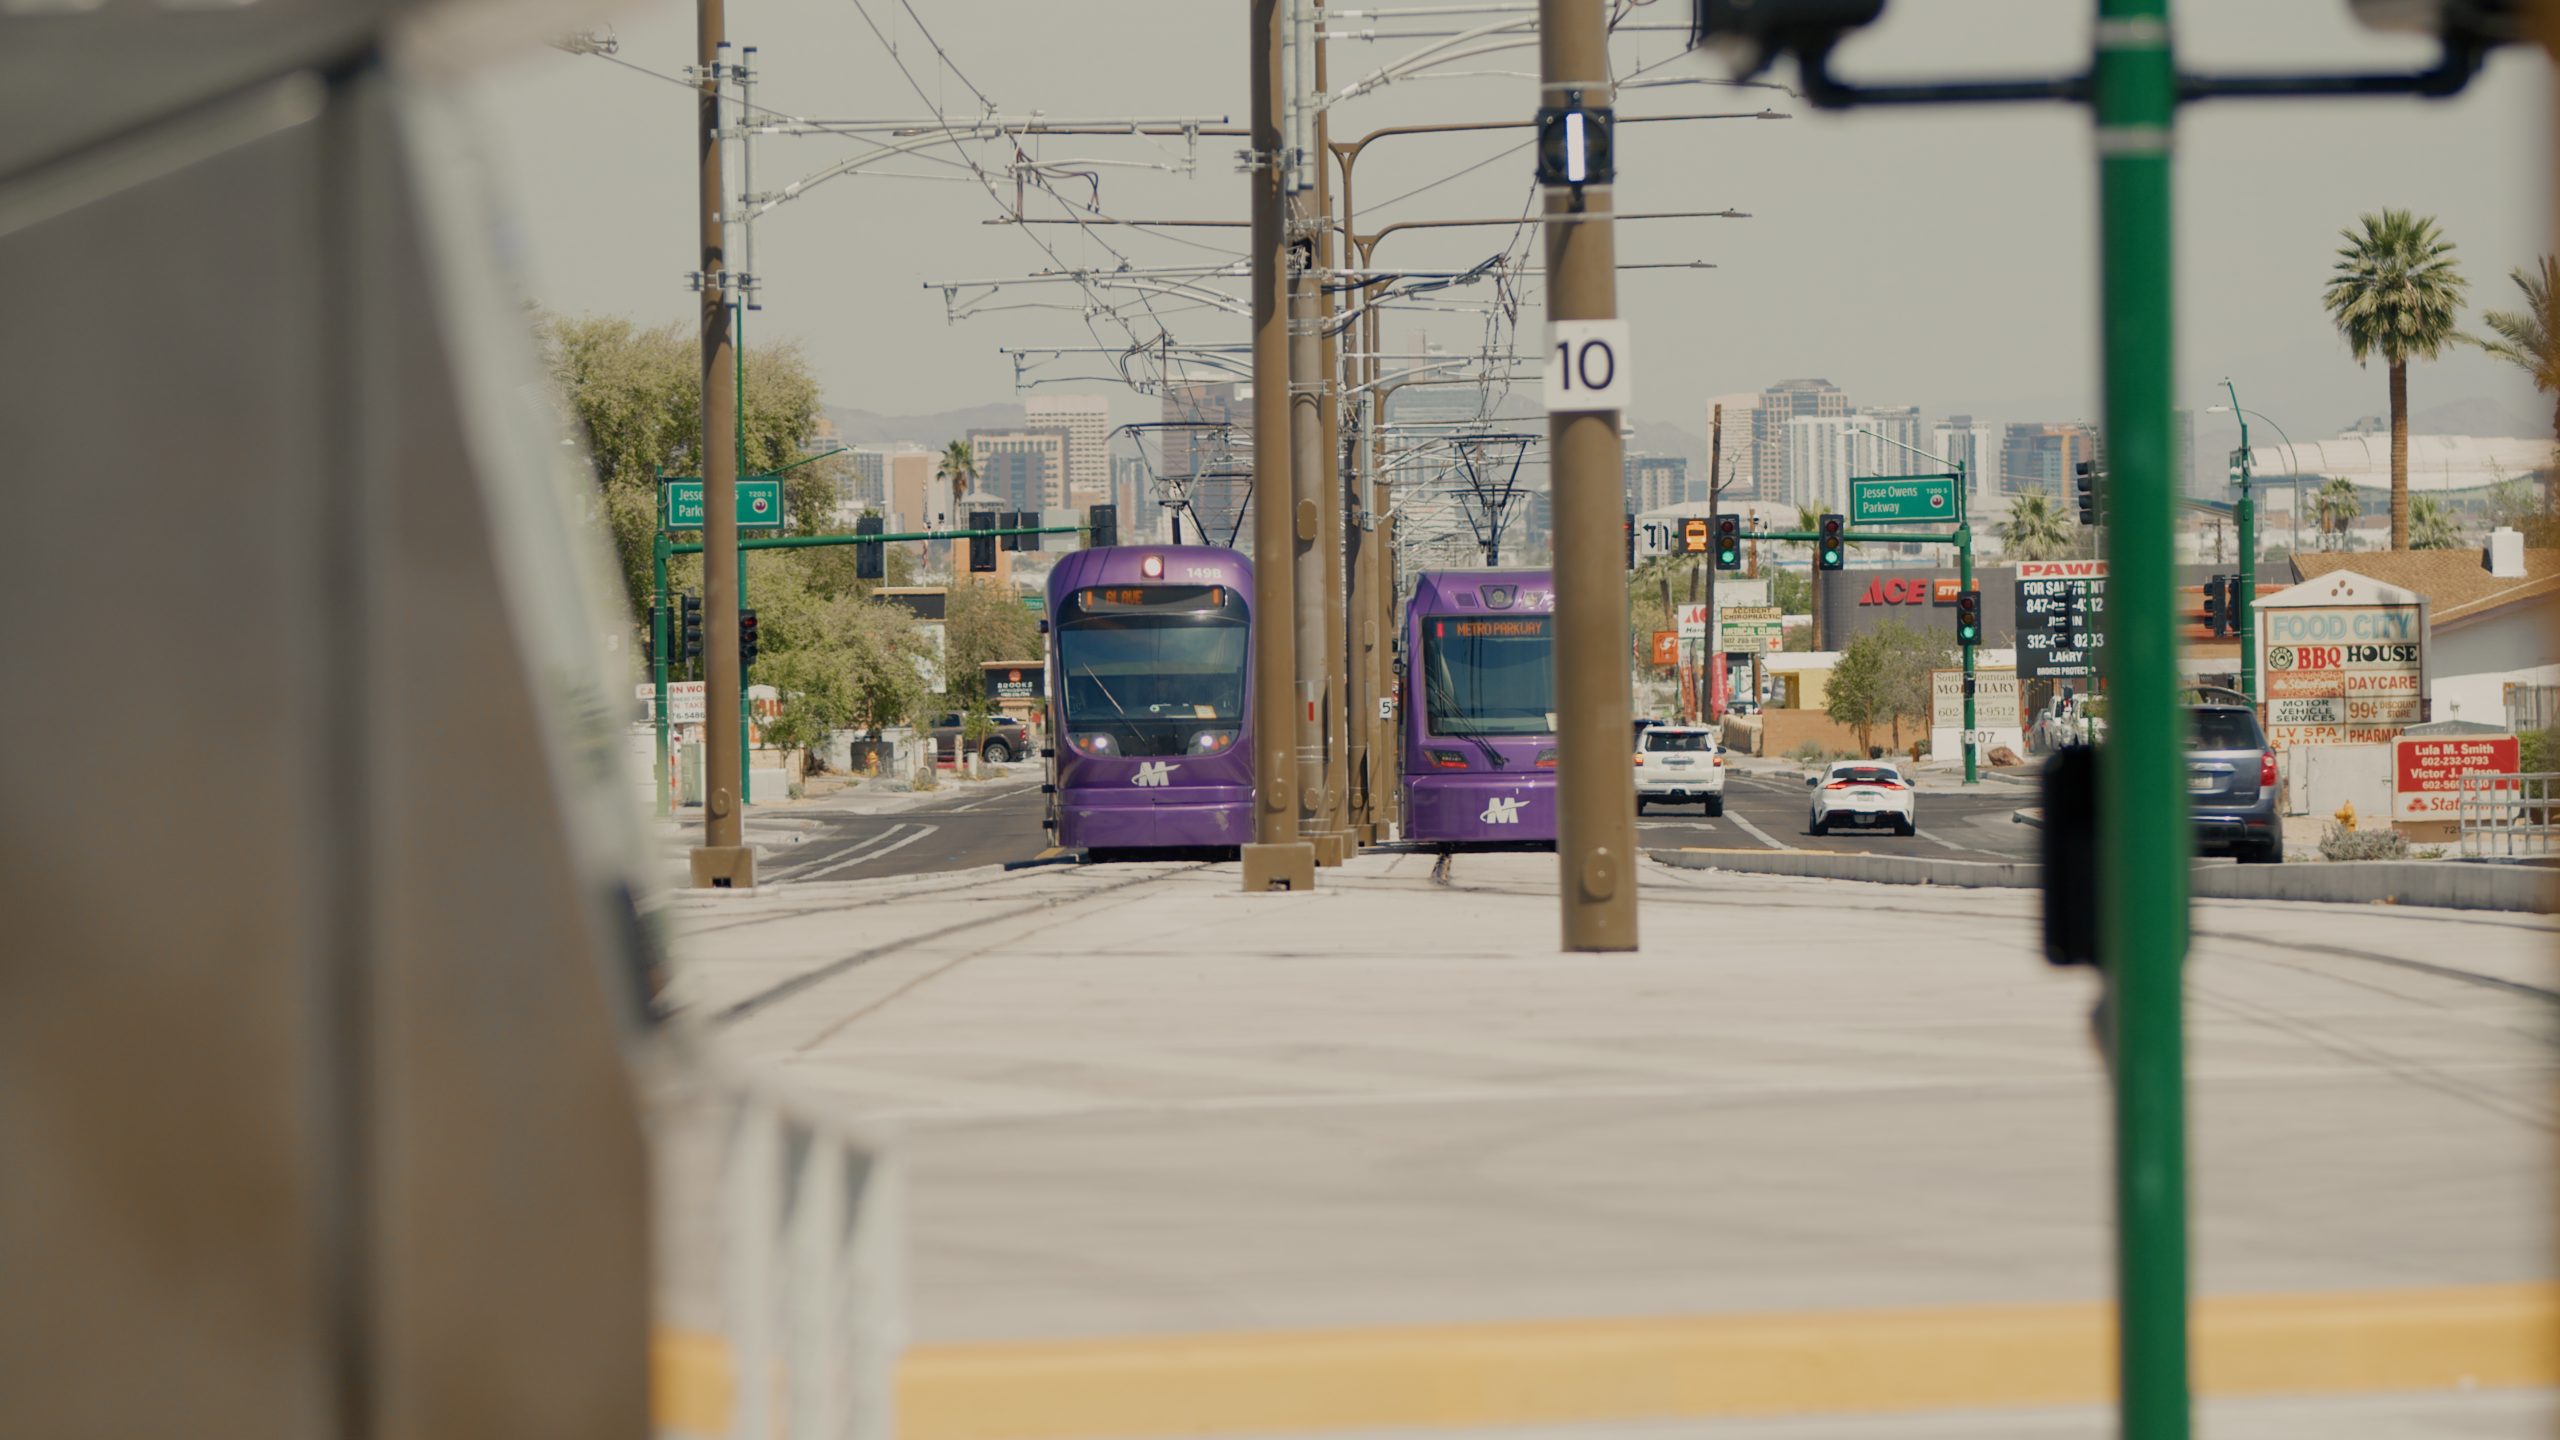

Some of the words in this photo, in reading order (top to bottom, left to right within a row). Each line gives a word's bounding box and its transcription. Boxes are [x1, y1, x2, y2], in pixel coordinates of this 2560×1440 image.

[1556, 340, 1614, 390] 10
[1863, 488, 1887, 499] Jesse
[1888, 486, 1918, 498] Owens
[1863, 503, 1900, 514] Parkway
[1186, 568, 1221, 578] 149B
[1859, 576, 1927, 605] ACE
[2023, 582, 2044, 595] FOR
[1456, 622, 1492, 636] METRO
[1493, 622, 1543, 635] PARKWAY
[2273, 615, 2346, 641] FOOD
[2353, 613, 2414, 640] CITY
[2049, 652, 2083, 662] LARRY
[2298, 646, 2341, 669] BBQ
[2347, 645, 2417, 662] HOUSE
[2348, 676, 2417, 690] DAYCARE
[1382, 702, 1391, 714] 5
[2380, 701, 2417, 709] DISCOUNT
[2280, 707, 2333, 715] VEHICLE
[2387, 710, 2411, 718] STORE
[2276, 714, 2336, 722] SERVICES
[2276, 728, 2297, 738] LV
[2304, 727, 2337, 737] SPA
[2415, 744, 2440, 755] Lula
[2443, 743, 2458, 754] M.
[2461, 743, 2494, 754] Smith
[2421, 756, 2489, 766] 602-232-0793
[2411, 768, 2446, 779] Victor
